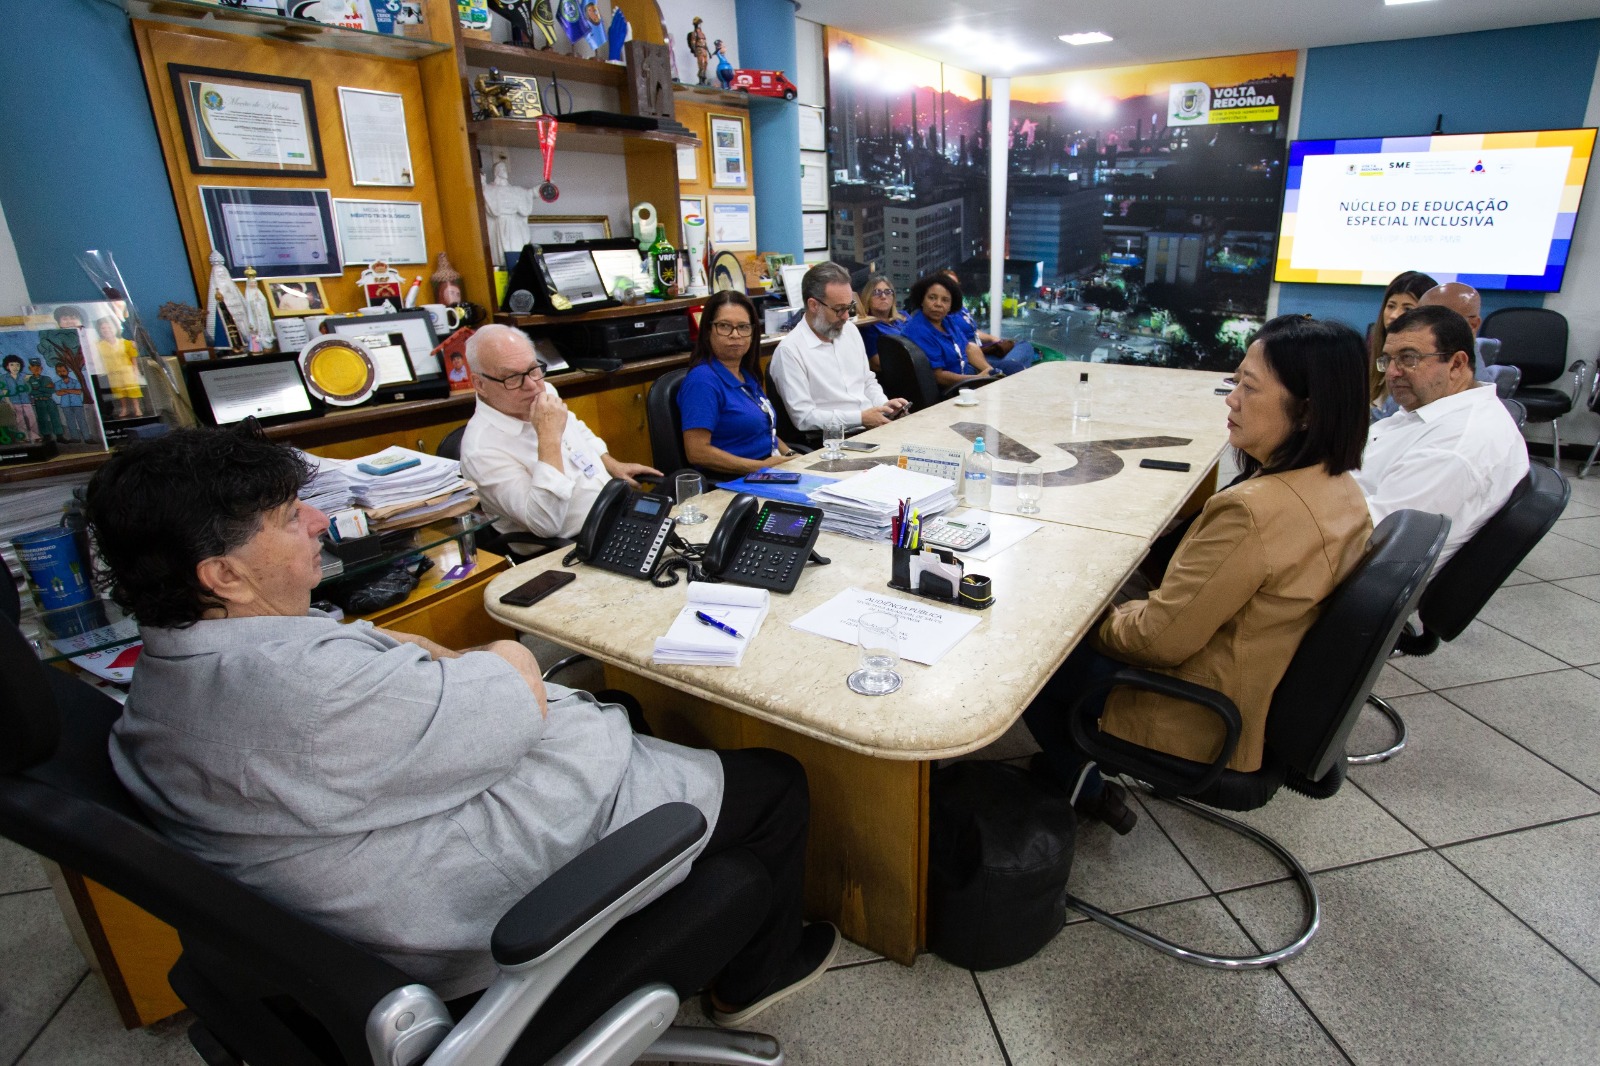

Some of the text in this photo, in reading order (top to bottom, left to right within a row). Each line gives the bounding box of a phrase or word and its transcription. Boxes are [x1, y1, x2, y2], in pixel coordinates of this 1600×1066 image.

[1214, 86, 1256, 98] VOLTA
[1213, 95, 1275, 108] REDONDA
[1389, 161, 1411, 169] SME
[1339, 197, 1509, 214] NÚCLEO DE EDUCAÇÃO
[1346, 216, 1494, 227] ESPECIAL INCLUSIVA
[865, 597, 943, 619] AUDIÊNCIA PÚBLICA
